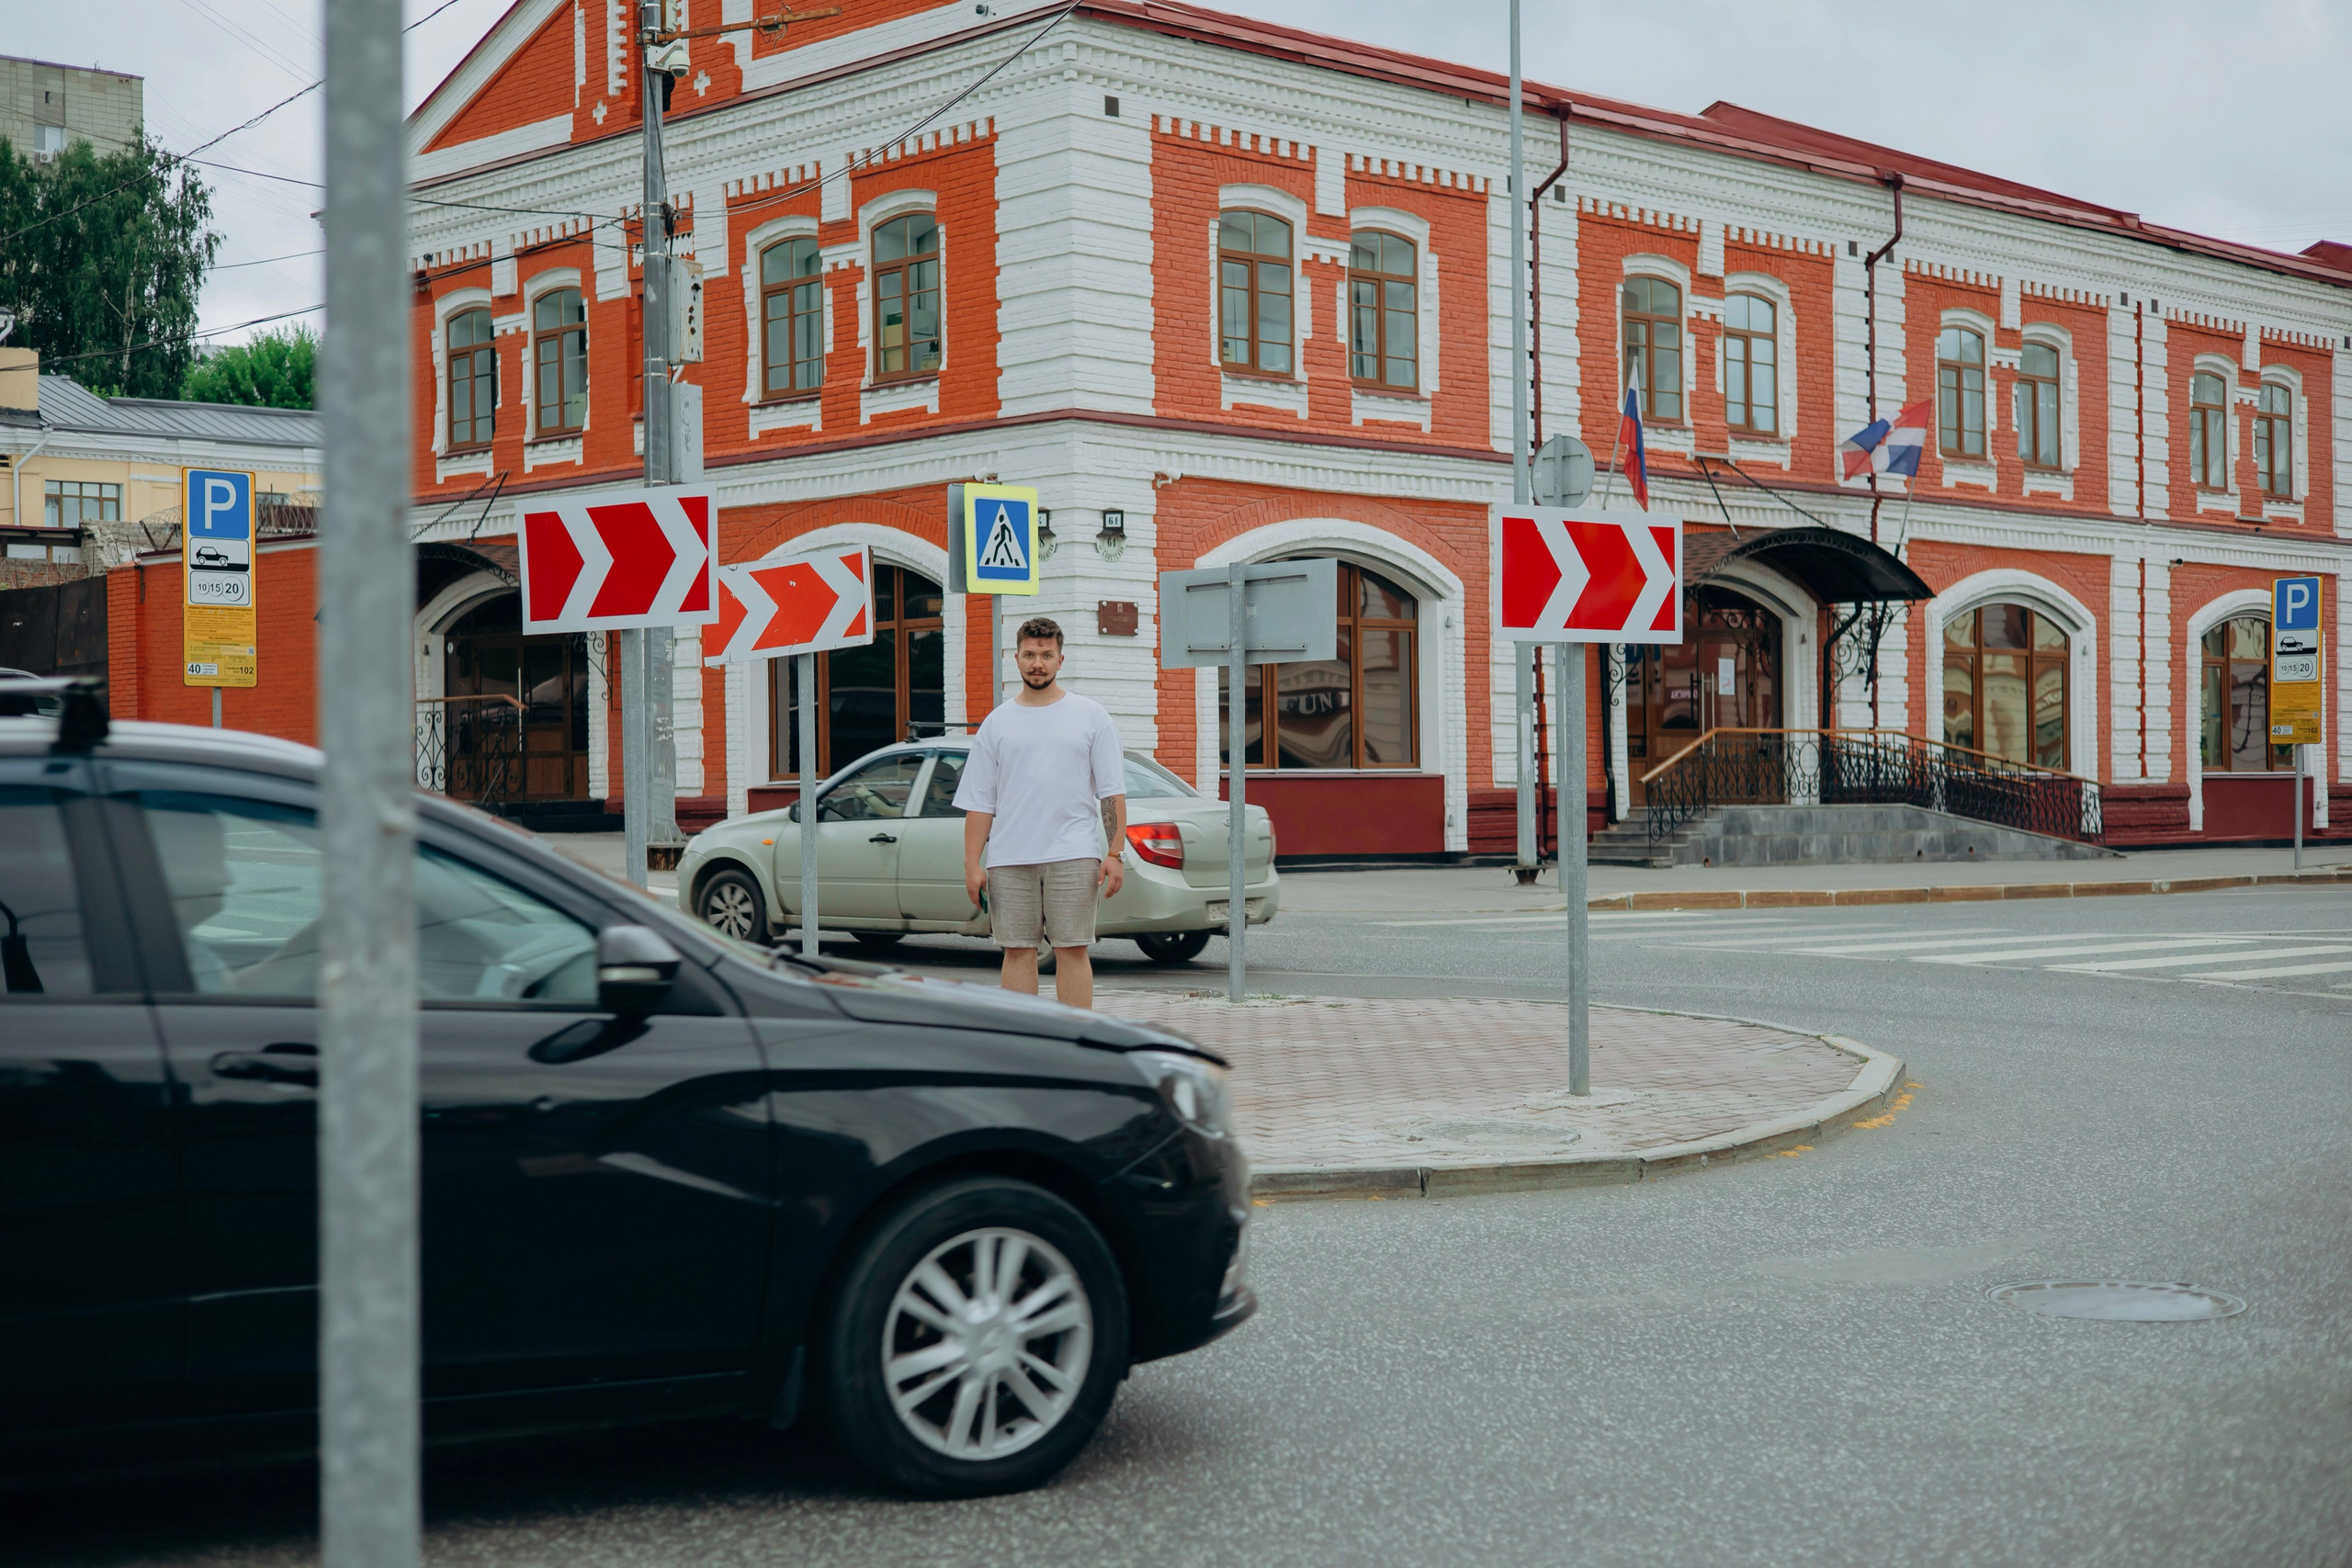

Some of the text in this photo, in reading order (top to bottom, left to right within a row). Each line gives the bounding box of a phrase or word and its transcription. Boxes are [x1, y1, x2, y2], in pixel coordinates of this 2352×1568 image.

[204, 478, 237, 530] P
[198, 582, 239, 594] 10 15 20
[2286, 583, 2310, 624] P
[188, 663, 201, 674] 40
[240, 666, 254, 675] 102
[2300, 663, 2310, 672] 20
